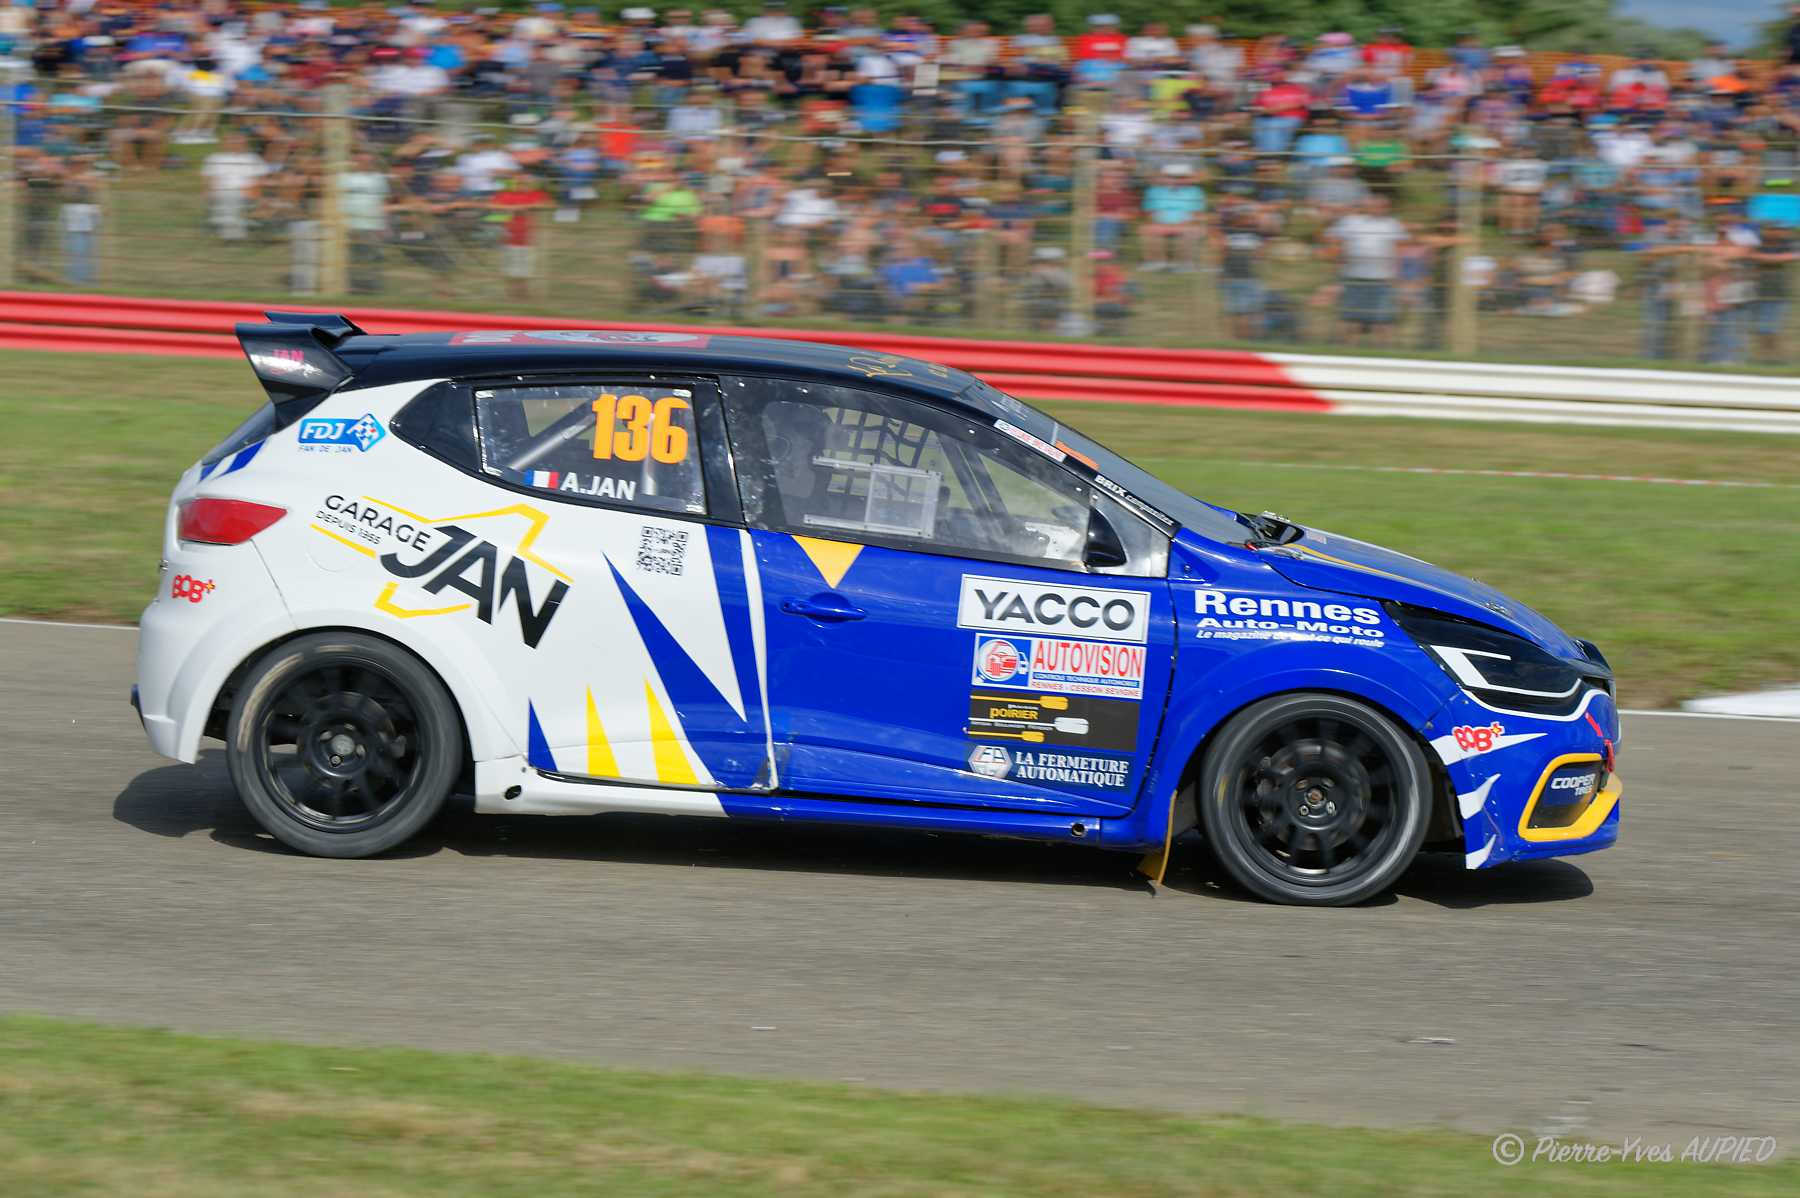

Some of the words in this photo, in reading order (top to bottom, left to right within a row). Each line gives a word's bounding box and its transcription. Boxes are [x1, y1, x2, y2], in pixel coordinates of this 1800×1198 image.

[301, 422, 346, 441] FDJ
[592, 393, 690, 465] 136
[560, 471, 637, 502] A.JAN
[1094, 474, 1129, 498] BRIX
[316, 510, 358, 534] DEPUIS
[325, 494, 431, 552] GARAGE
[380, 524, 571, 650] JAN
[974, 588, 1136, 632] YACCO
[1194, 589, 1381, 625] Rennes
[1196, 616, 1385, 638] Auto-Moto
[1196, 629, 1213, 638] Le
[1033, 639, 1143, 679] AUTOVISION
[1032, 681, 1064, 690] RENNES
[1015, 751, 1035, 766] LA
[1037, 753, 1129, 774] FERMETURE
[1016, 766, 1125, 788] AUTOMATIQUE
[1551, 773, 1596, 790] COOPER
